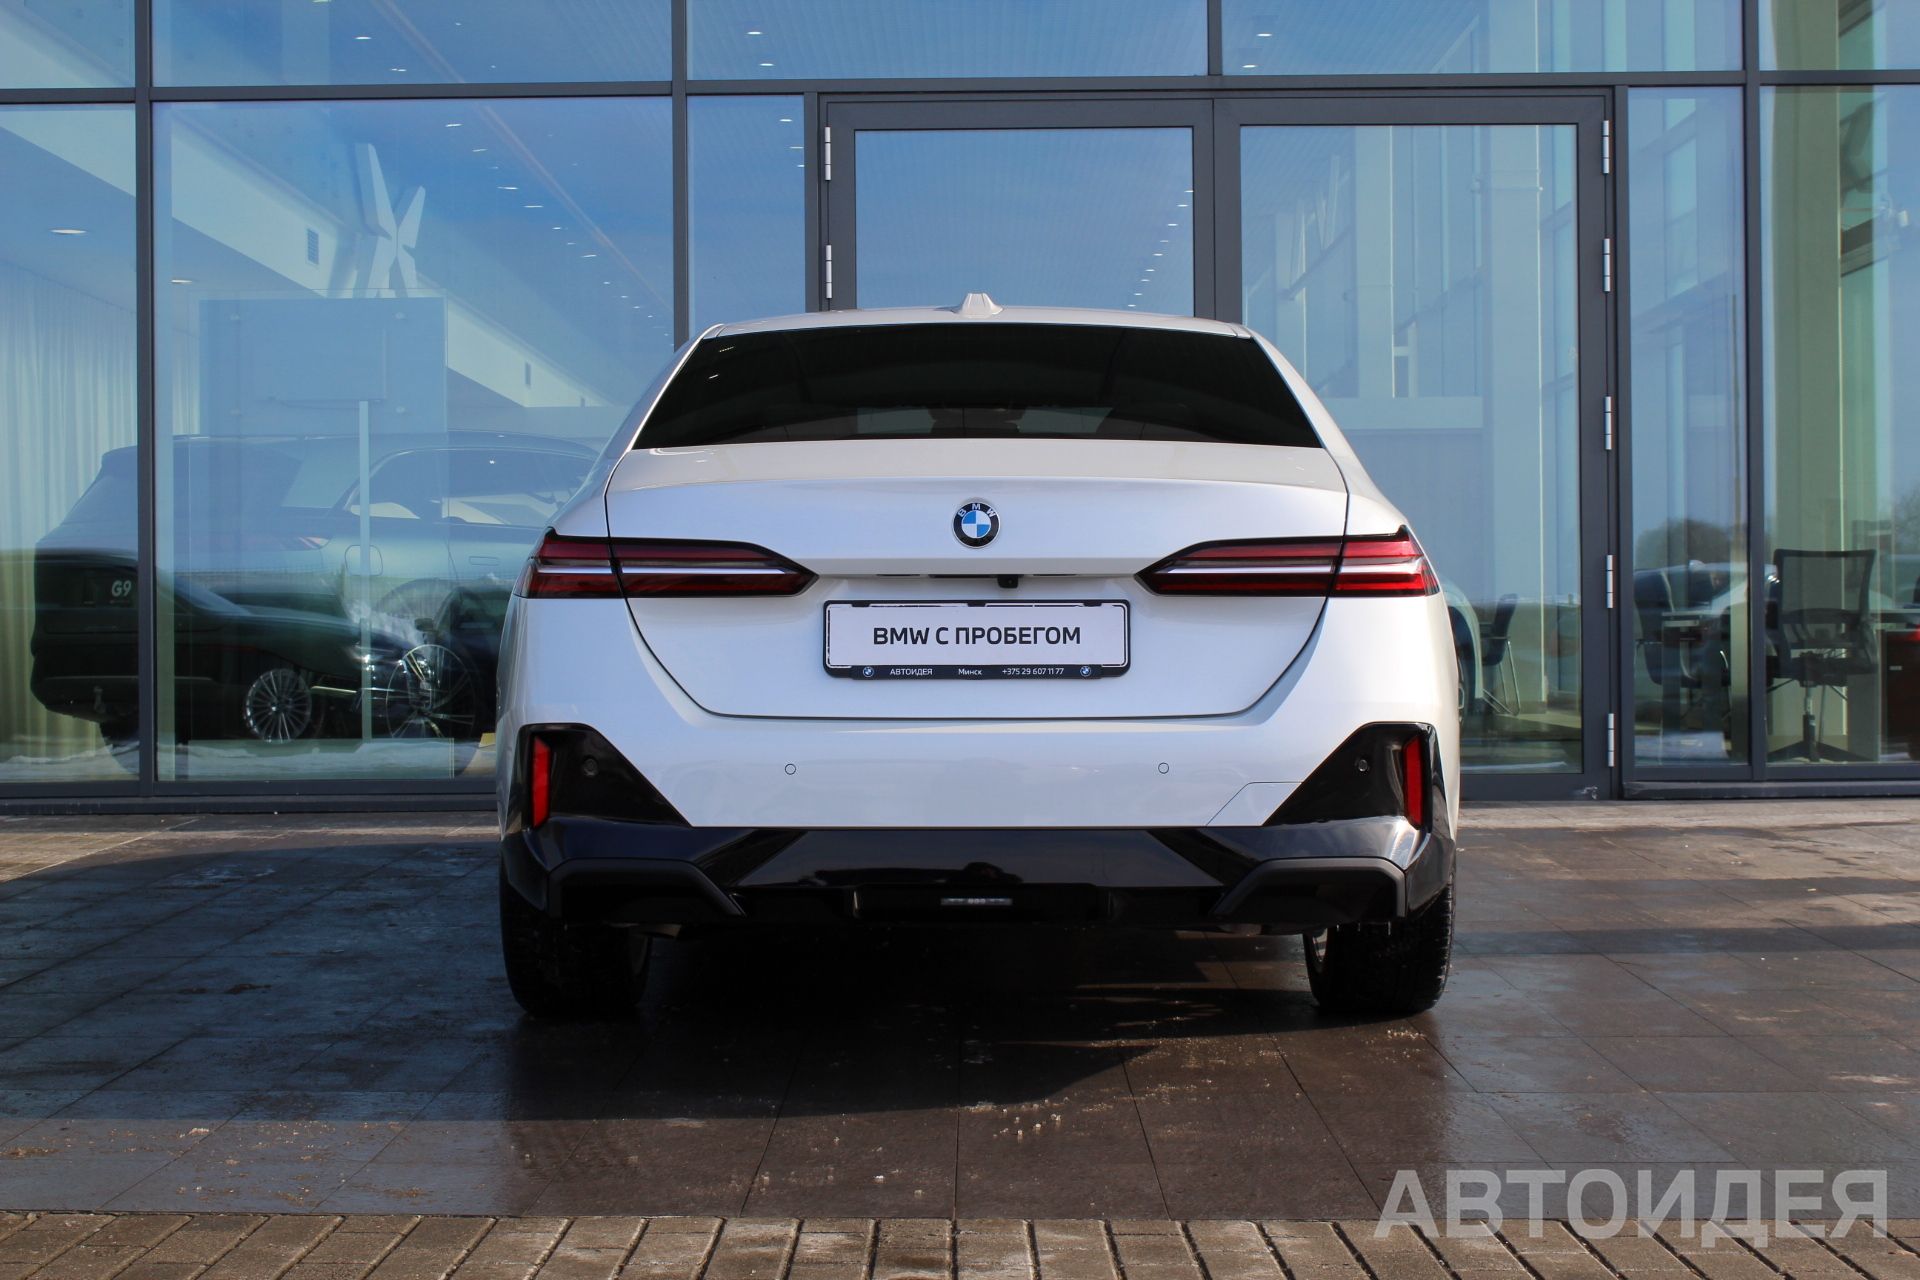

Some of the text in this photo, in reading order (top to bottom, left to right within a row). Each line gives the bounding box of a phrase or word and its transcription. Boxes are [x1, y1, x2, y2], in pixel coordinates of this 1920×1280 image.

[957, 503, 996, 517] BMW
[111, 580, 132, 597] G9
[873, 627, 930, 645] BMW
[955, 627, 1081, 645] ПРОБЕГОМ
[889, 668, 934, 677] АВТОИДЕЯ
[958, 668, 983, 677] Минск
[1002, 667, 1020, 675] +375
[1021, 667, 1031, 675] 29
[1032, 667, 1047, 675] 607
